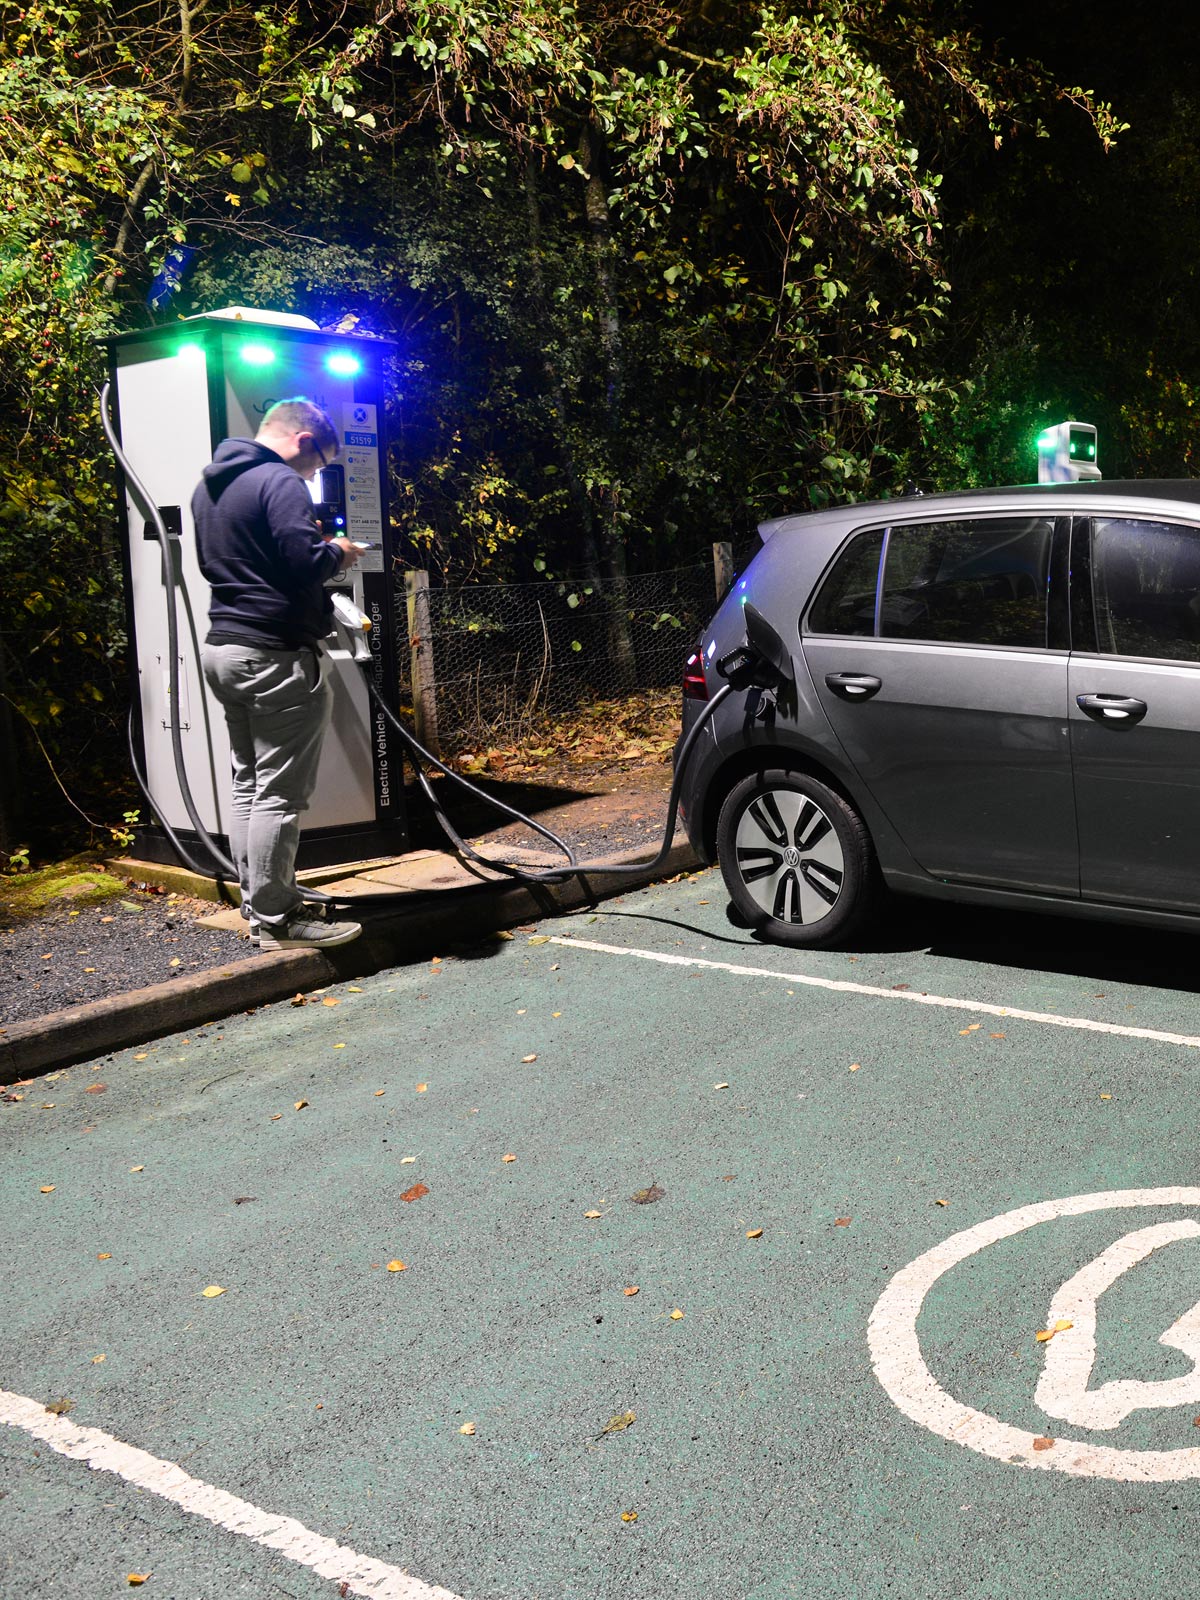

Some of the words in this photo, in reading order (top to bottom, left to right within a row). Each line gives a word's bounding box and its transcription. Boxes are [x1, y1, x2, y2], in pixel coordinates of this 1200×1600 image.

[350, 436, 372, 445] 51519
[370, 602, 382, 651] Charger
[376, 712, 387, 758] Vehicle
[378, 760, 390, 806] Electric
